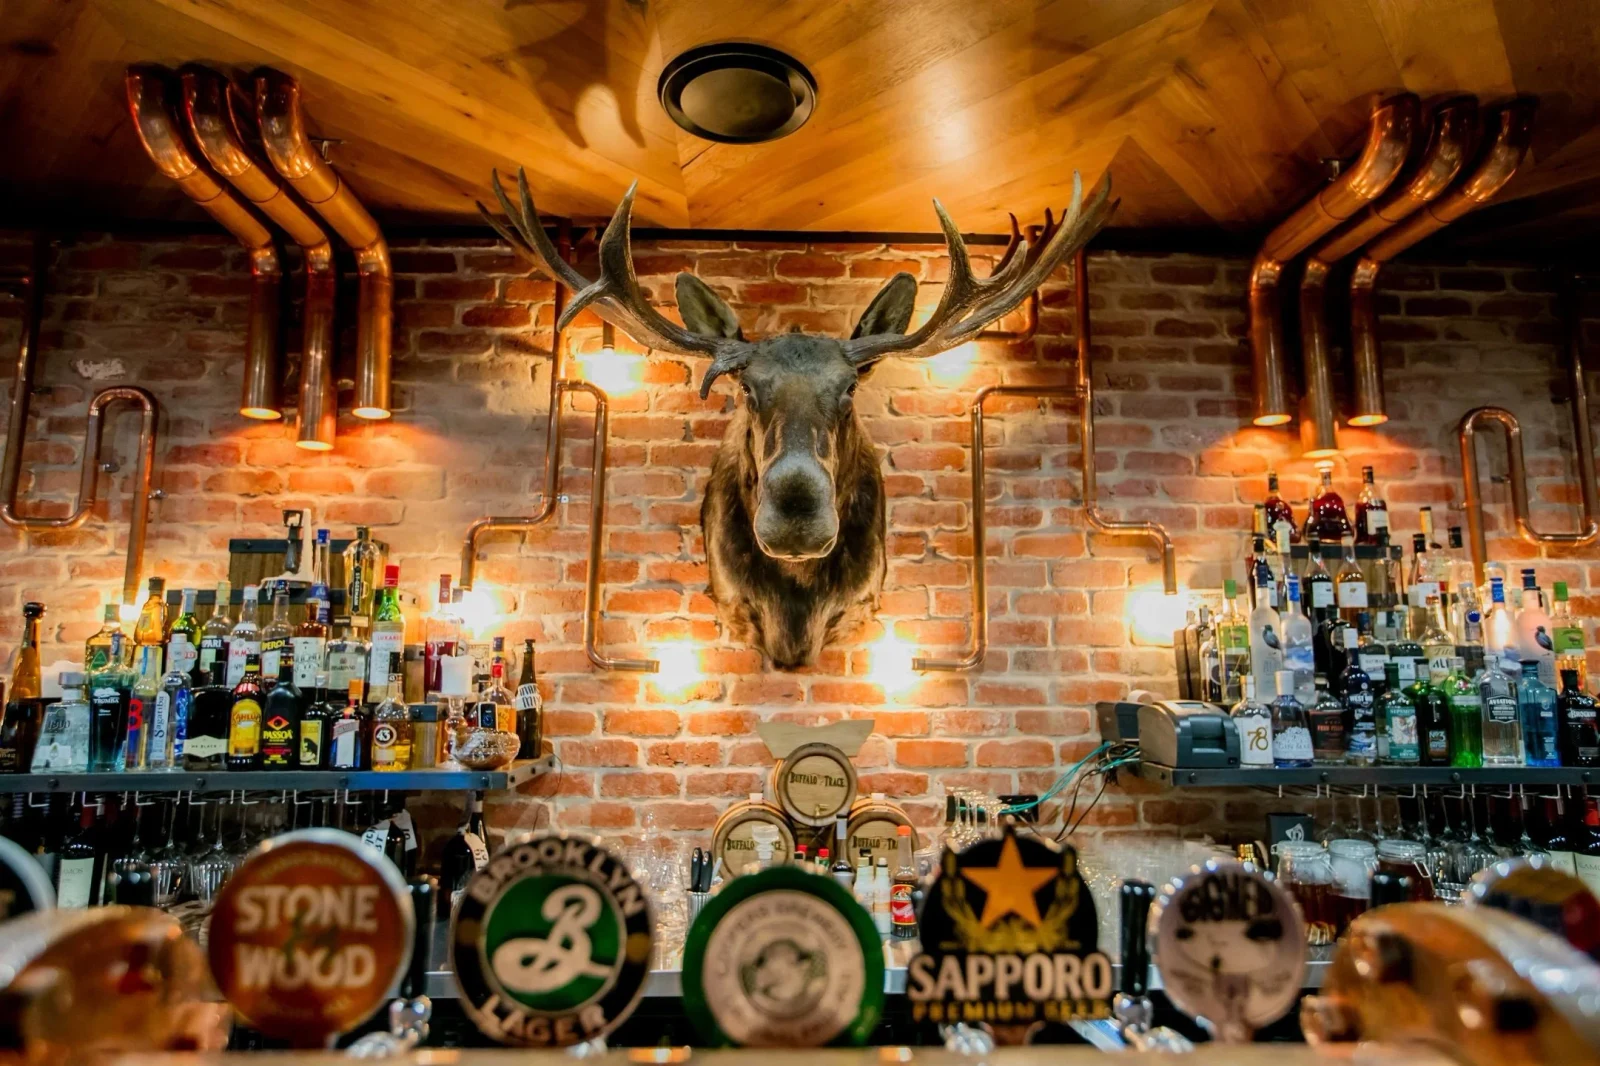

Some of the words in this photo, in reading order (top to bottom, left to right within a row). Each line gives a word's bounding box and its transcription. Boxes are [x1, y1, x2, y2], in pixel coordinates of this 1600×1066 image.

[202, 639, 222, 648] PARI
[154, 696, 166, 738] Sagatiba
[376, 729, 391, 742] 43
[1247, 726, 1269, 751] 78
[789, 771, 818, 785] BUFFALO
[824, 775, 846, 788] TRACE
[726, 838, 755, 851] BUFFALO
[852, 835, 880, 848] BUFFALO
[470, 838, 646, 918] BROOKLYN
[234, 884, 380, 934] STONE
[236, 943, 377, 990] WOOD
[908, 951, 1113, 1001] SAPPORO
[477, 993, 608, 1042] LAGER
[912, 1001, 1036, 1022] PREMIUM
